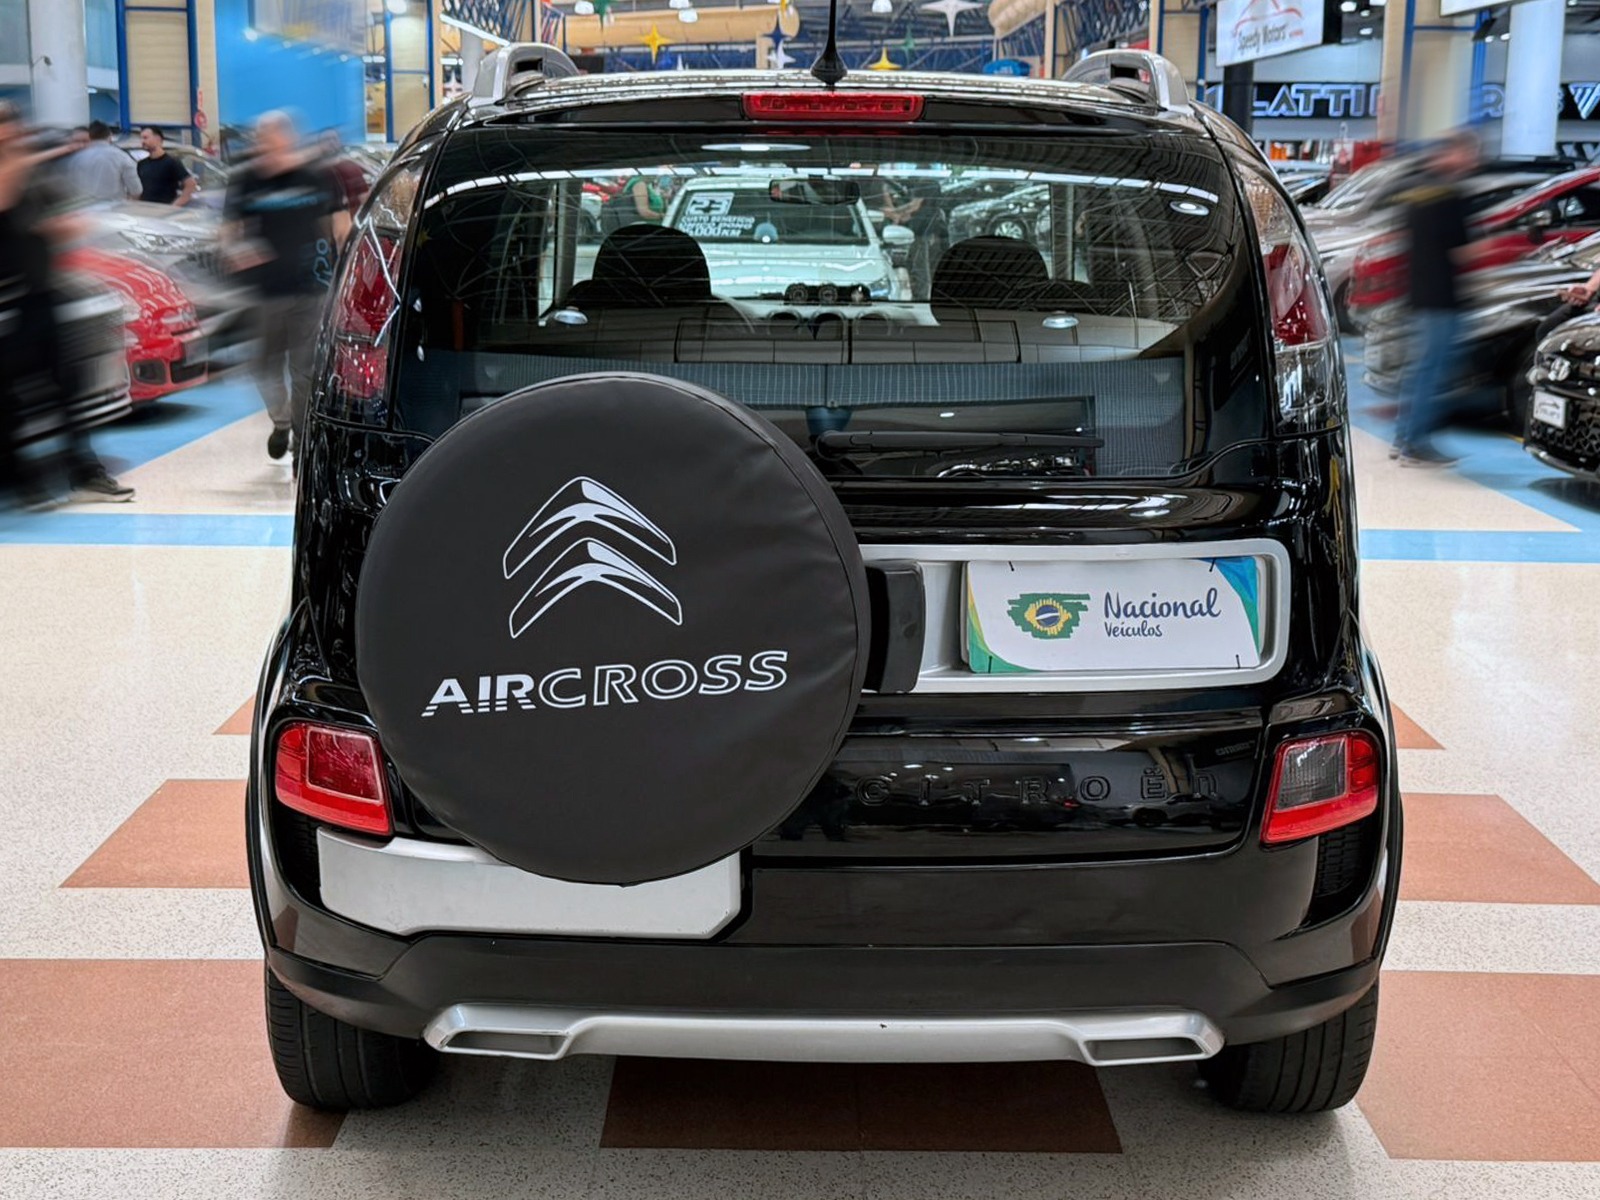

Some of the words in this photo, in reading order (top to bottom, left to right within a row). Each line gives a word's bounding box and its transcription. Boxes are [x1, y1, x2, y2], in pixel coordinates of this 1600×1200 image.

[688, 198, 729, 215] 23
[1103, 587, 1222, 620] Nacional
[1103, 620, 1163, 638] Veículos
[420, 650, 789, 717] AIRCROSS
